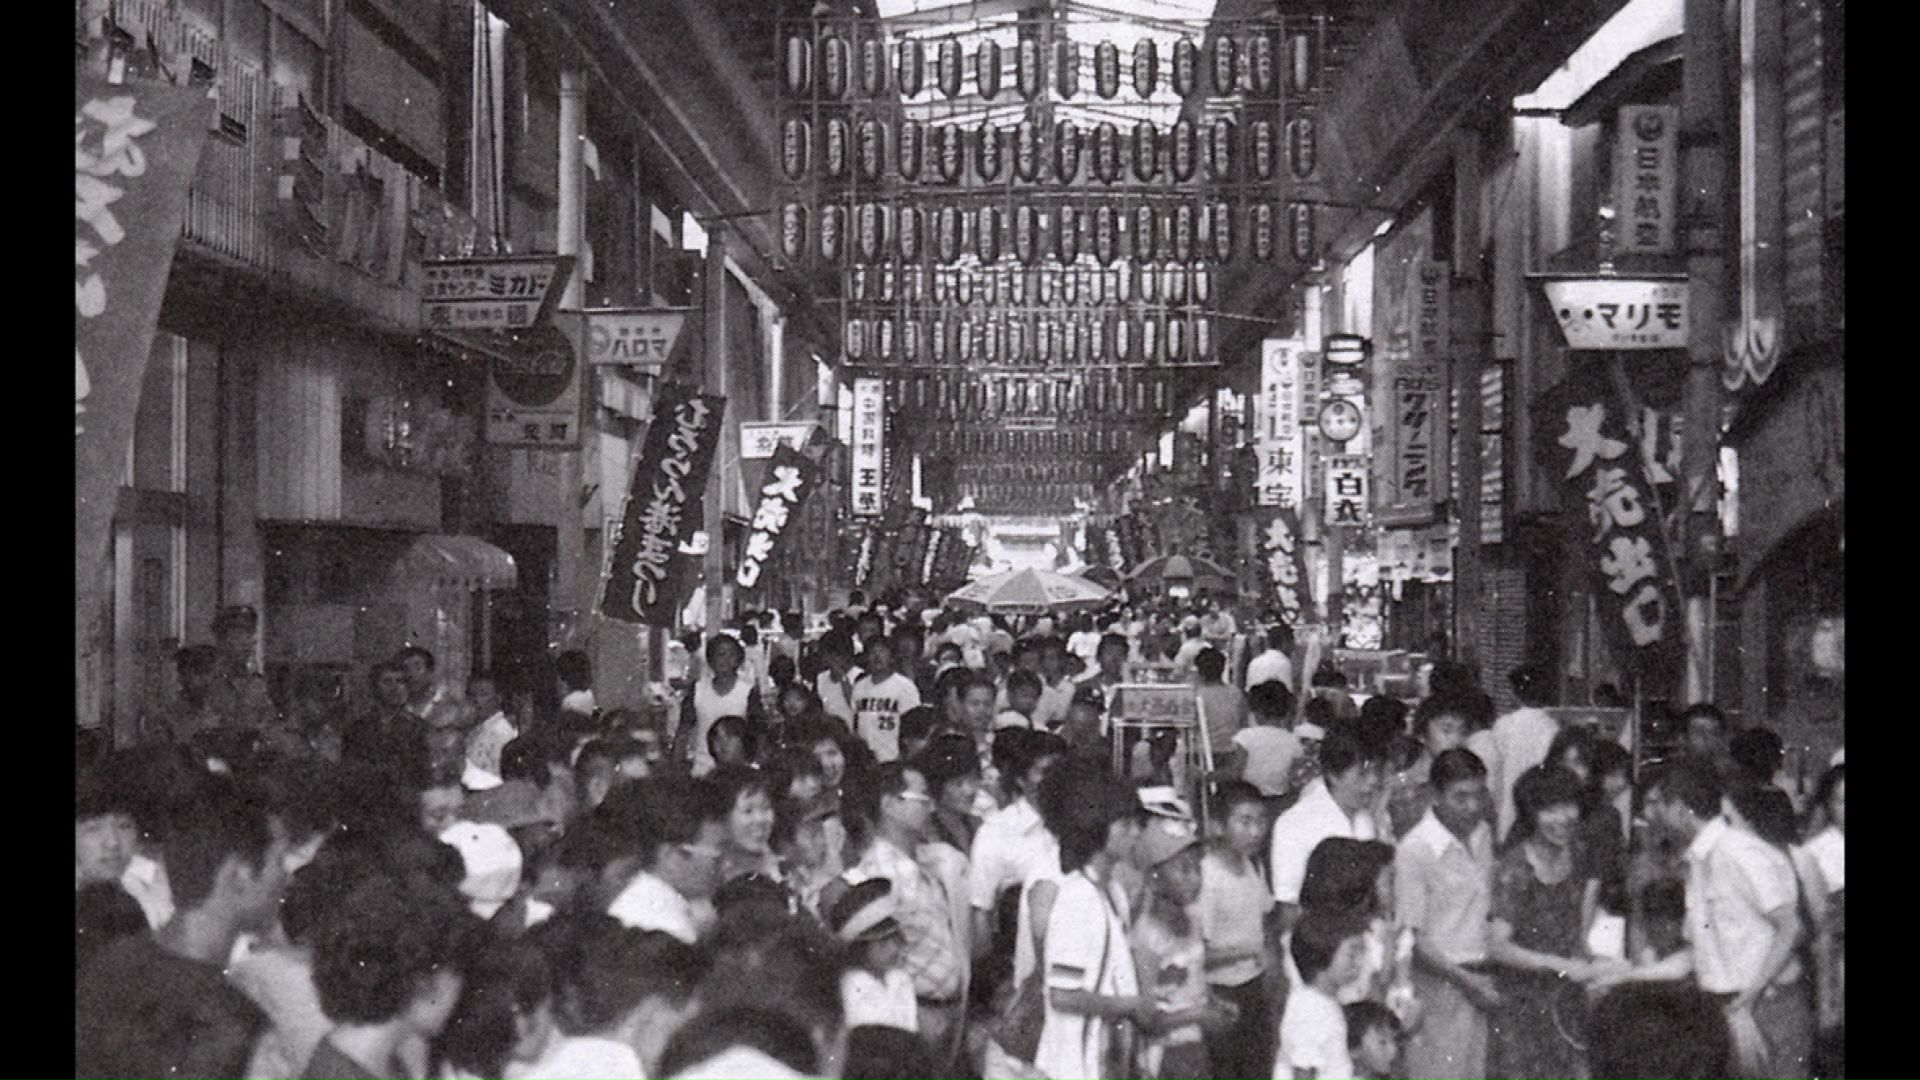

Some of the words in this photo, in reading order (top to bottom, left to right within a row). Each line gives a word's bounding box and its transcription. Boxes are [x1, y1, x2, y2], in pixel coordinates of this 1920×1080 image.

[489, 273, 548, 296] ミカド
[1596, 303, 1682, 331] マリモ
